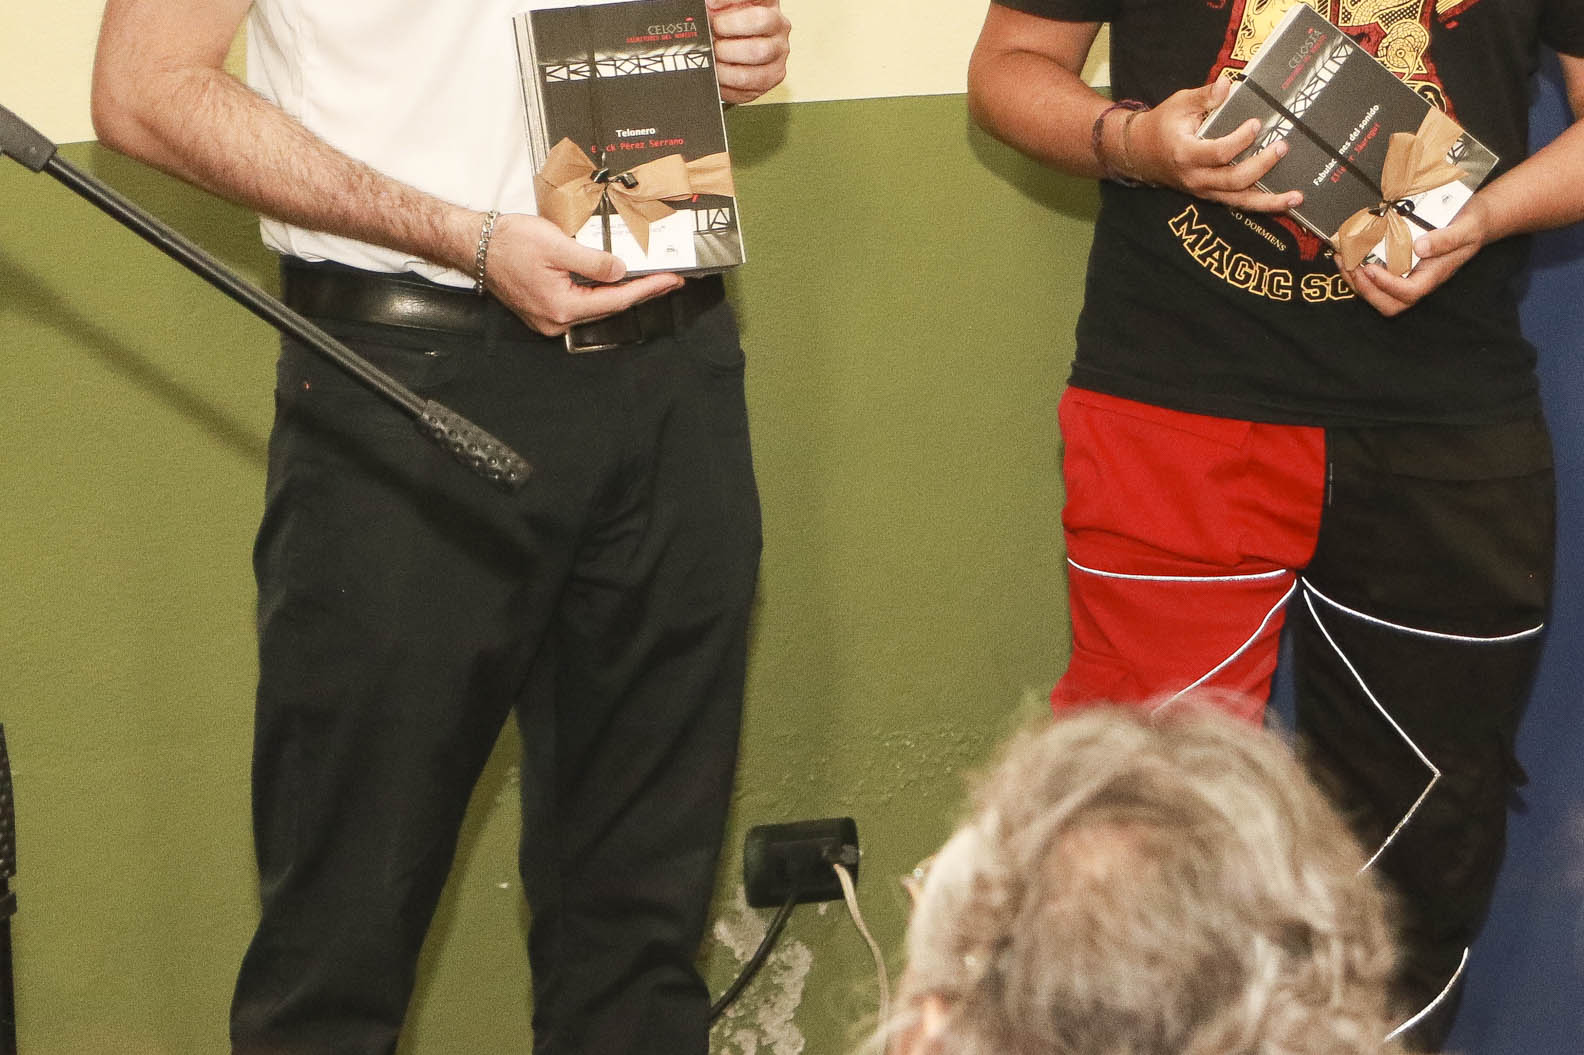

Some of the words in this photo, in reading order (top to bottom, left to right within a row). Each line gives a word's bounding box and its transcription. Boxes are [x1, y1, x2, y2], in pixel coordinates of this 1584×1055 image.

[591, 144, 616, 153] Eck
[649, 138, 684, 147] Serrano
[616, 128, 656, 137] Telonero
[1313, 141, 1351, 186] Fabulacnes
[1349, 128, 1360, 142] del
[1359, 105, 1379, 129] sonido
[1244, 217, 1287, 252] DORMIENS
[1168, 204, 1292, 301] MAGIC
